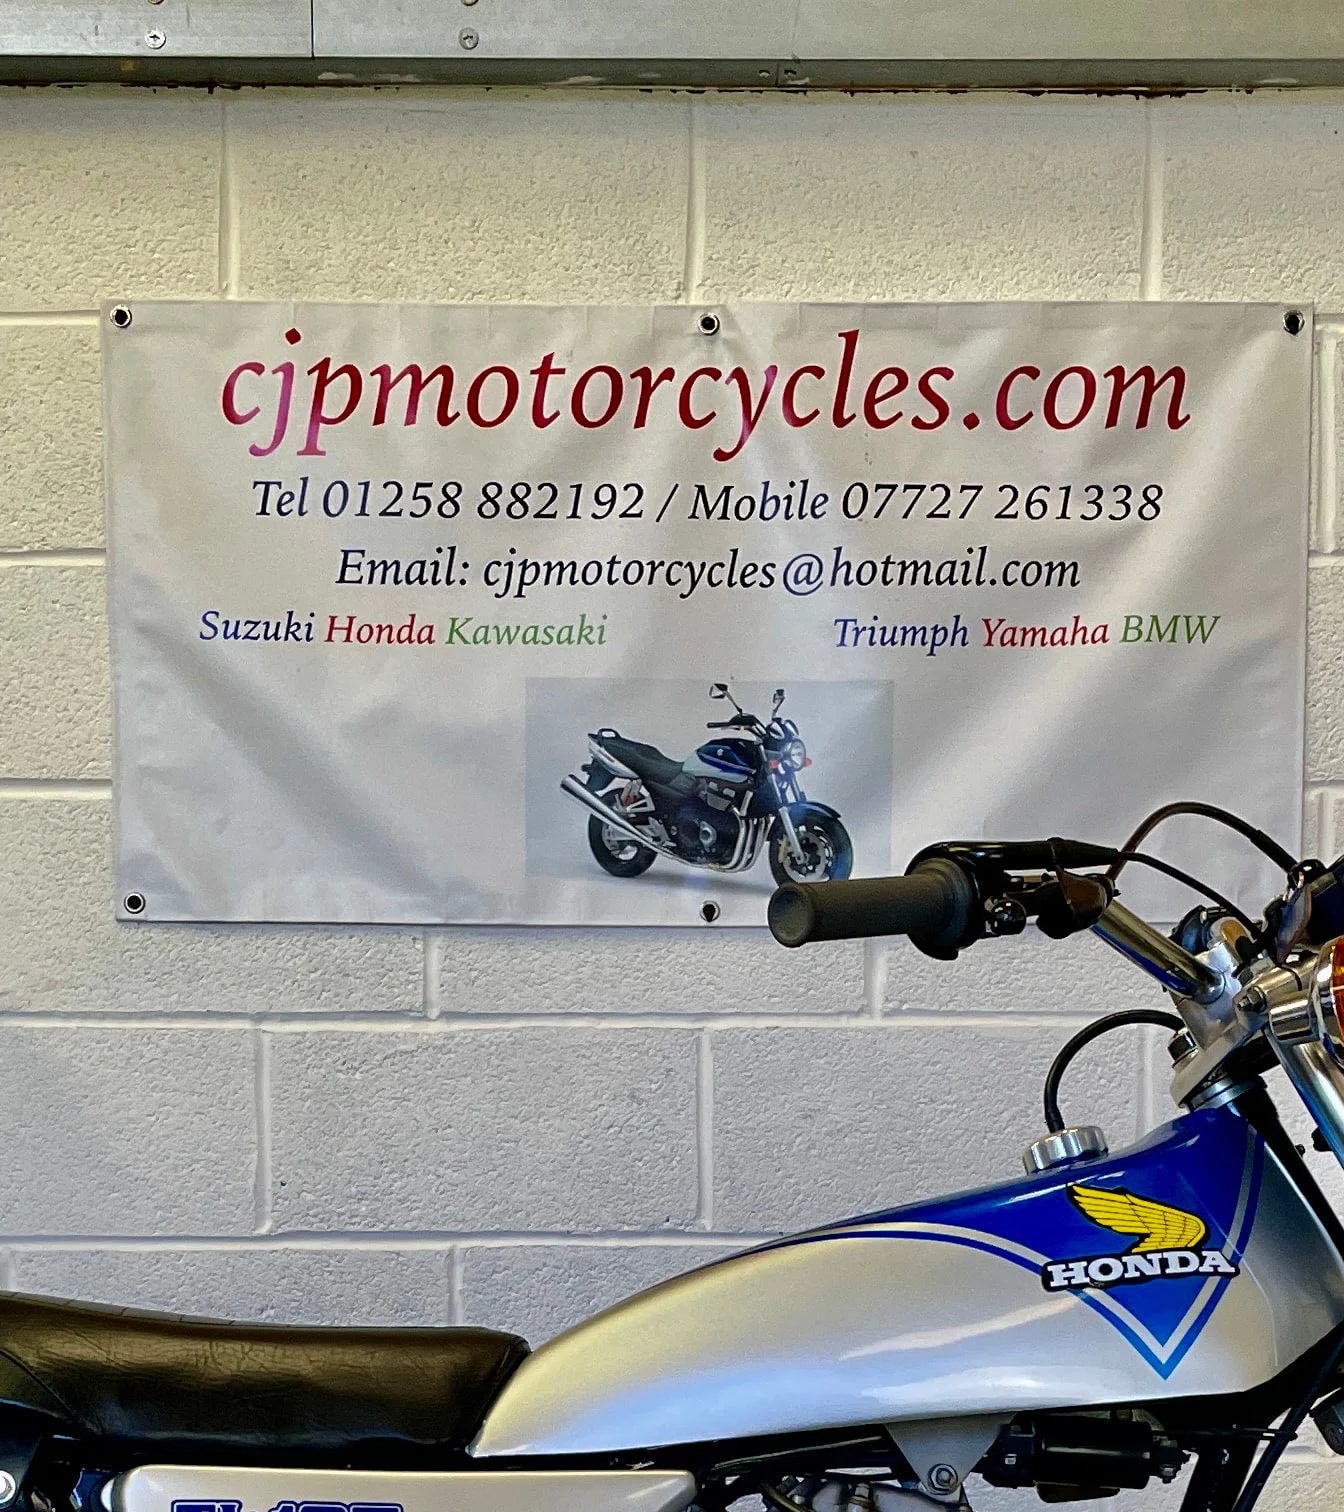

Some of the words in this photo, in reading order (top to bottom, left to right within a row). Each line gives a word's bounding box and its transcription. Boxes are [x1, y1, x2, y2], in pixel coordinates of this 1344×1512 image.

[219, 327, 1192, 463] cjpmotorcycles.com
[252, 476, 310, 518] Tel
[321, 479, 464, 520] 01258
[475, 480, 647, 521] 882192
[656, 483, 680, 523] /
[687, 478, 831, 523] Mobile
[840, 481, 985, 521] 07727
[993, 482, 1166, 523] 261338
[334, 546, 471, 588] Email:
[482, 545, 1081, 601] cjpmotorcycles@hotmail.com
[199, 608, 316, 644] Suzuki
[323, 612, 436, 646] Honda
[444, 613, 608, 646] Kawasaki
[833, 615, 970, 650] Triumph
[981, 614, 1112, 648] Yamaha
[1119, 613, 1222, 645] BMW
[1047, 1251, 1236, 1288] HONDA
